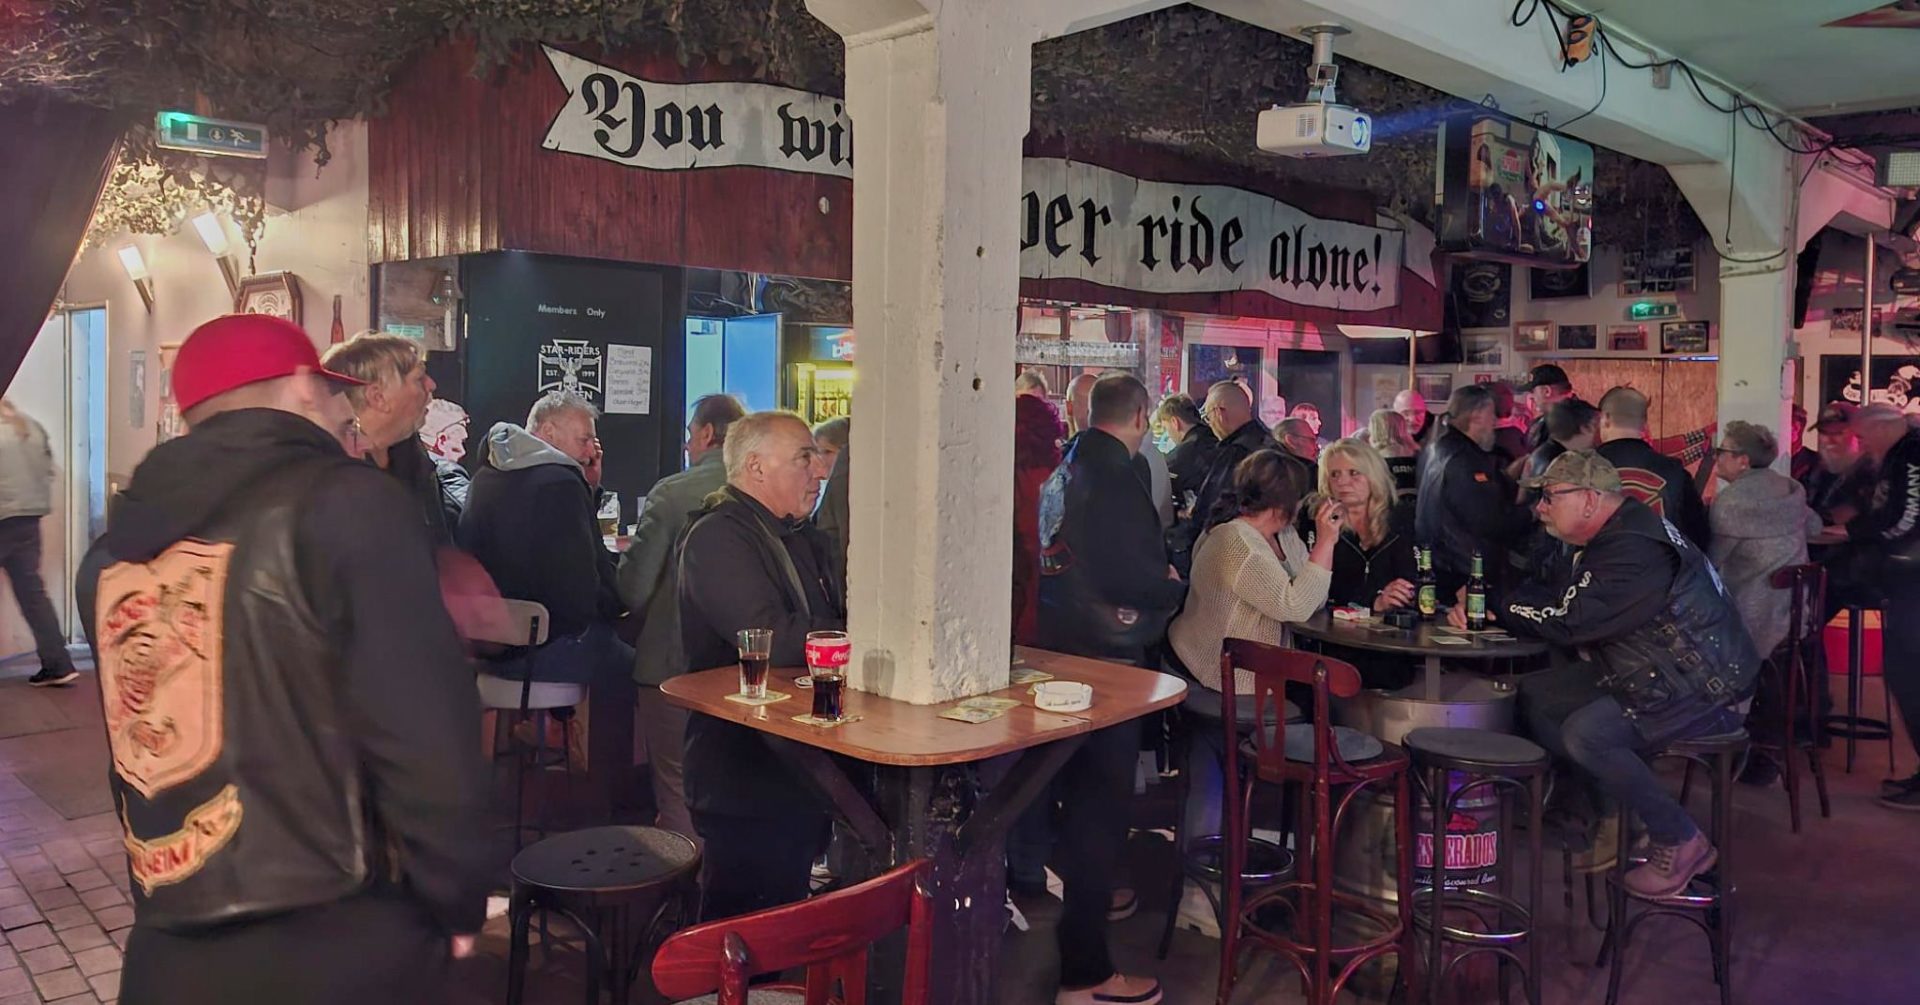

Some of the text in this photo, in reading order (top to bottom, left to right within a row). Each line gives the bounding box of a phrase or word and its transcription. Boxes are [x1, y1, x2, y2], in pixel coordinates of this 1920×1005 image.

[582, 73, 725, 158] You
[777, 102, 853, 167] wi
[1137, 195, 1244, 275] ride
[1269, 223, 1382, 298] alone!
[538, 304, 607, 318] Members Only
[540, 345, 600, 356] STAR-RIDERS
[1415, 831, 1497, 870] ESERADOS
